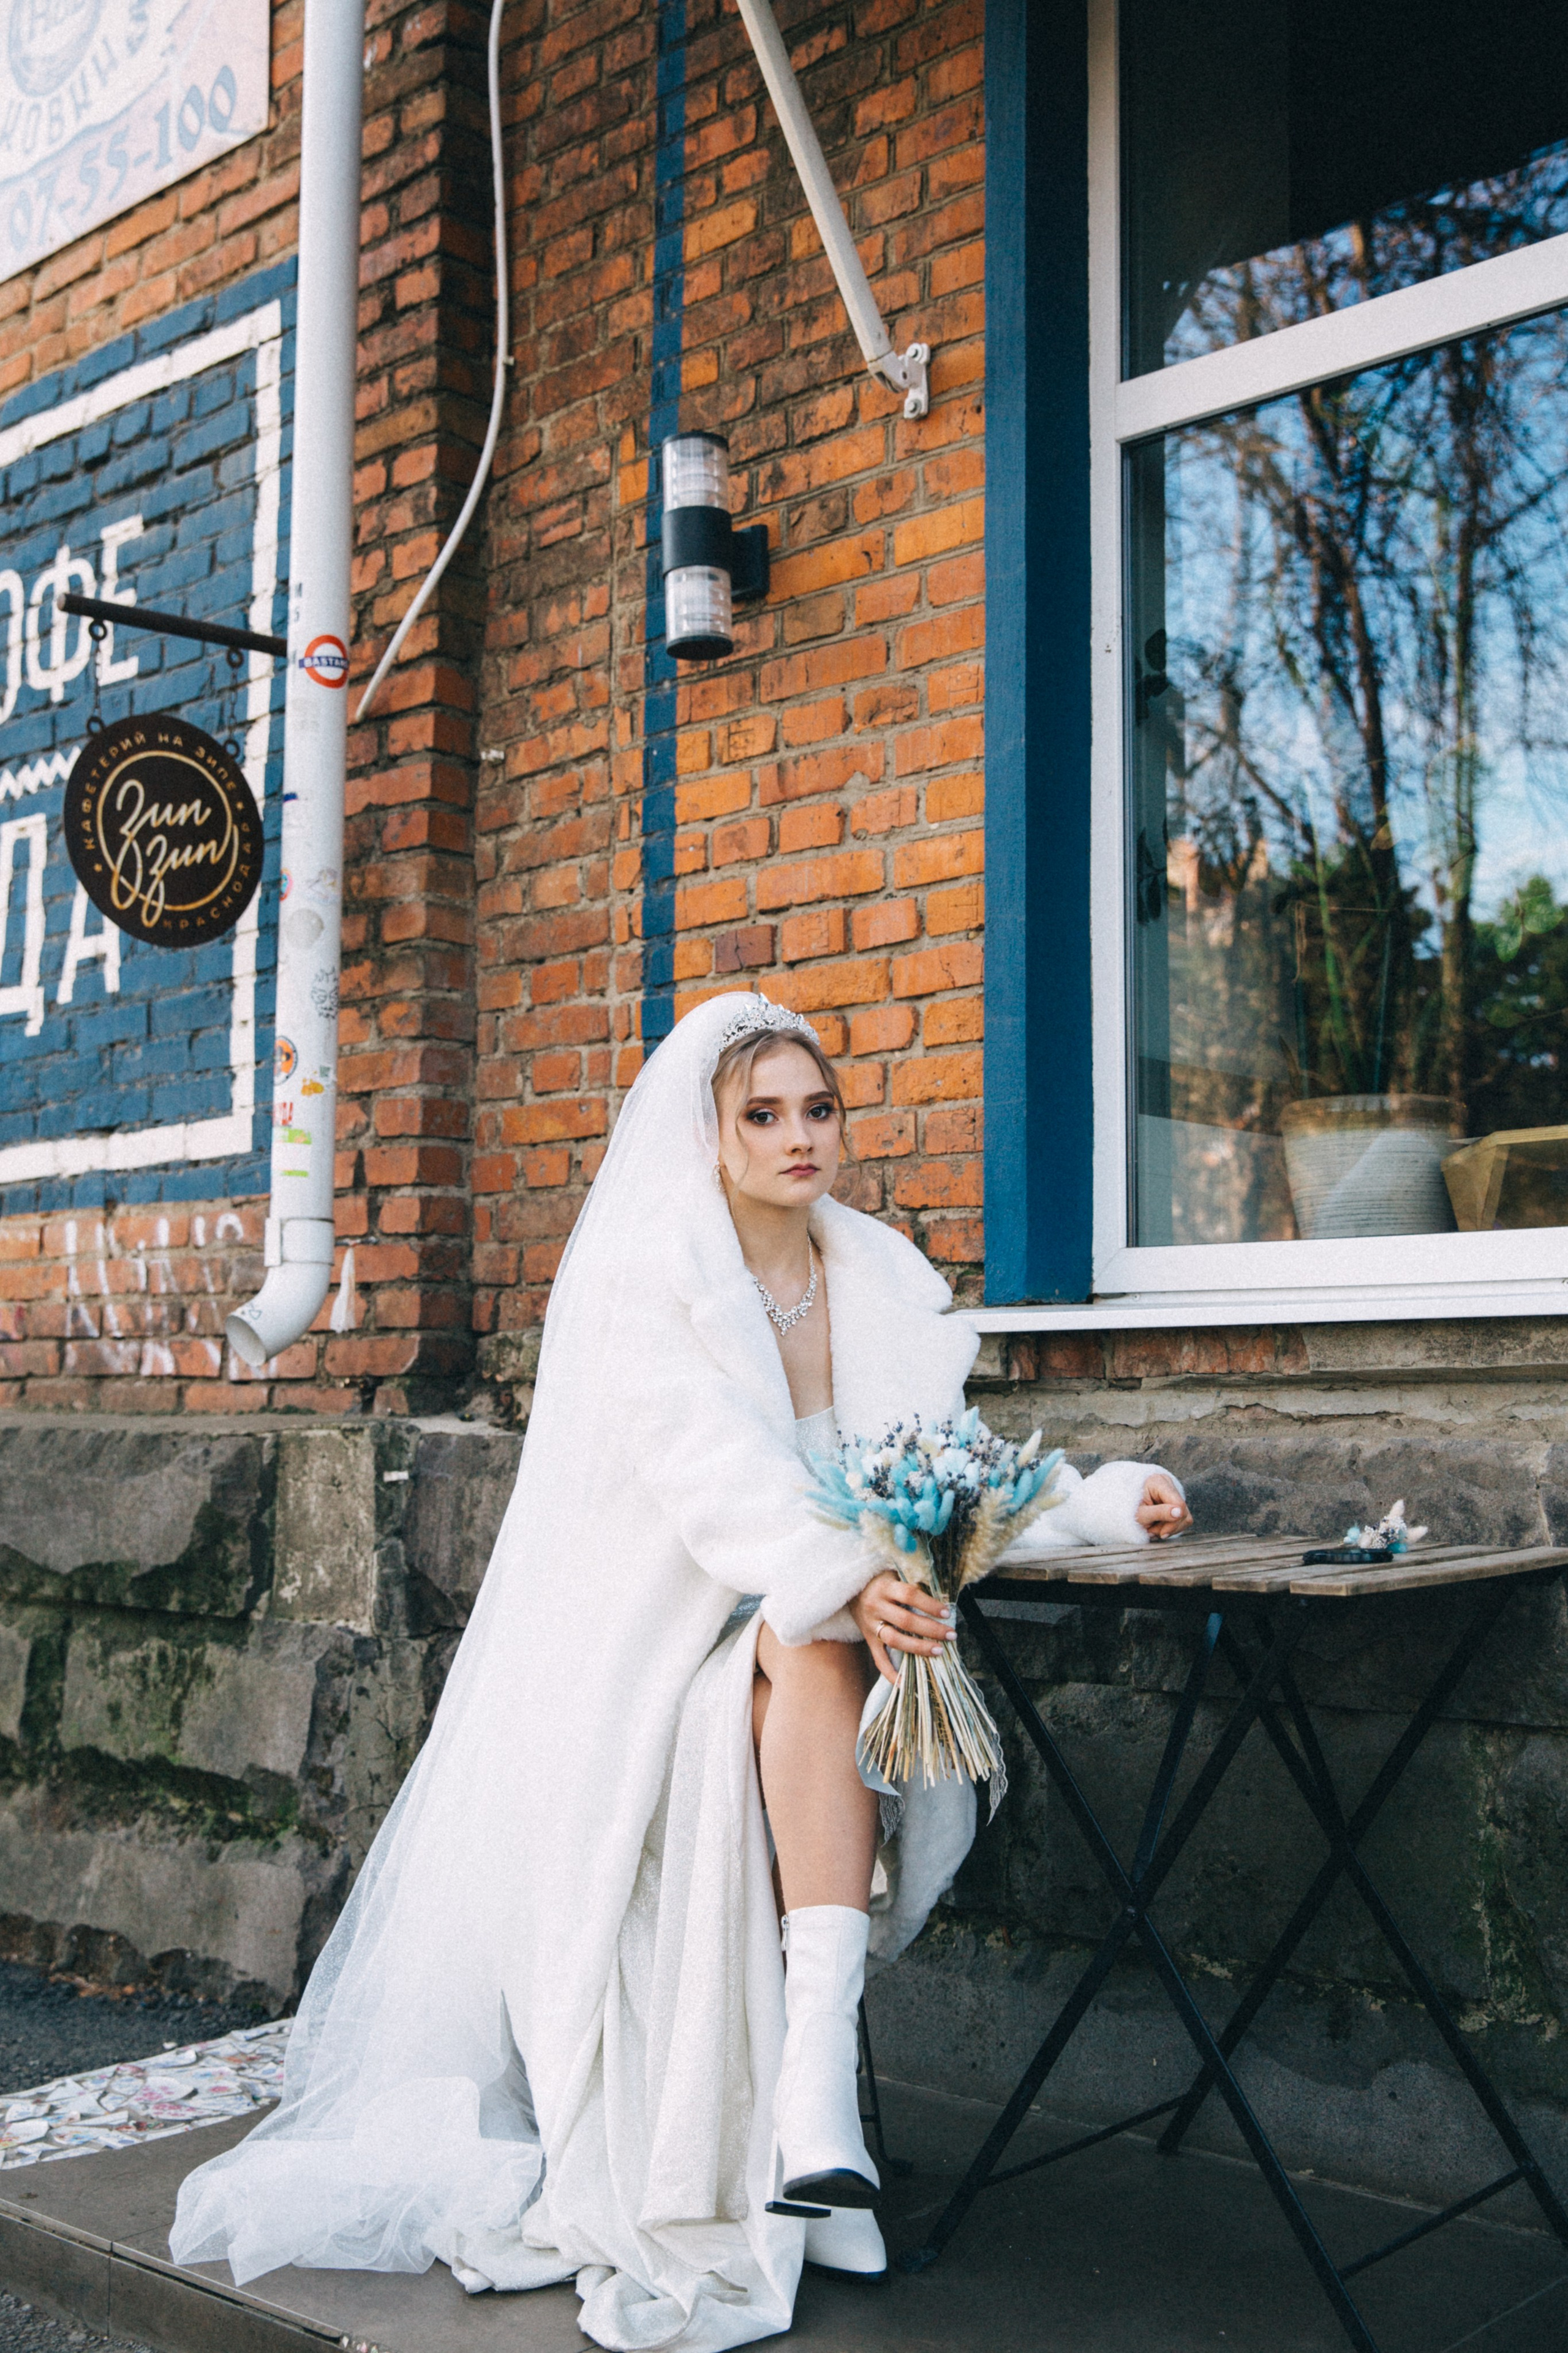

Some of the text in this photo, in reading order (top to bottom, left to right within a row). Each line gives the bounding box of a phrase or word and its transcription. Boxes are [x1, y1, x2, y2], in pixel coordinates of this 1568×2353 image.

[81, 731, 236, 850] КАФЕТЕРИЙ НА ЗИПЕ
[162, 822, 252, 929] КРАСНОДАР
